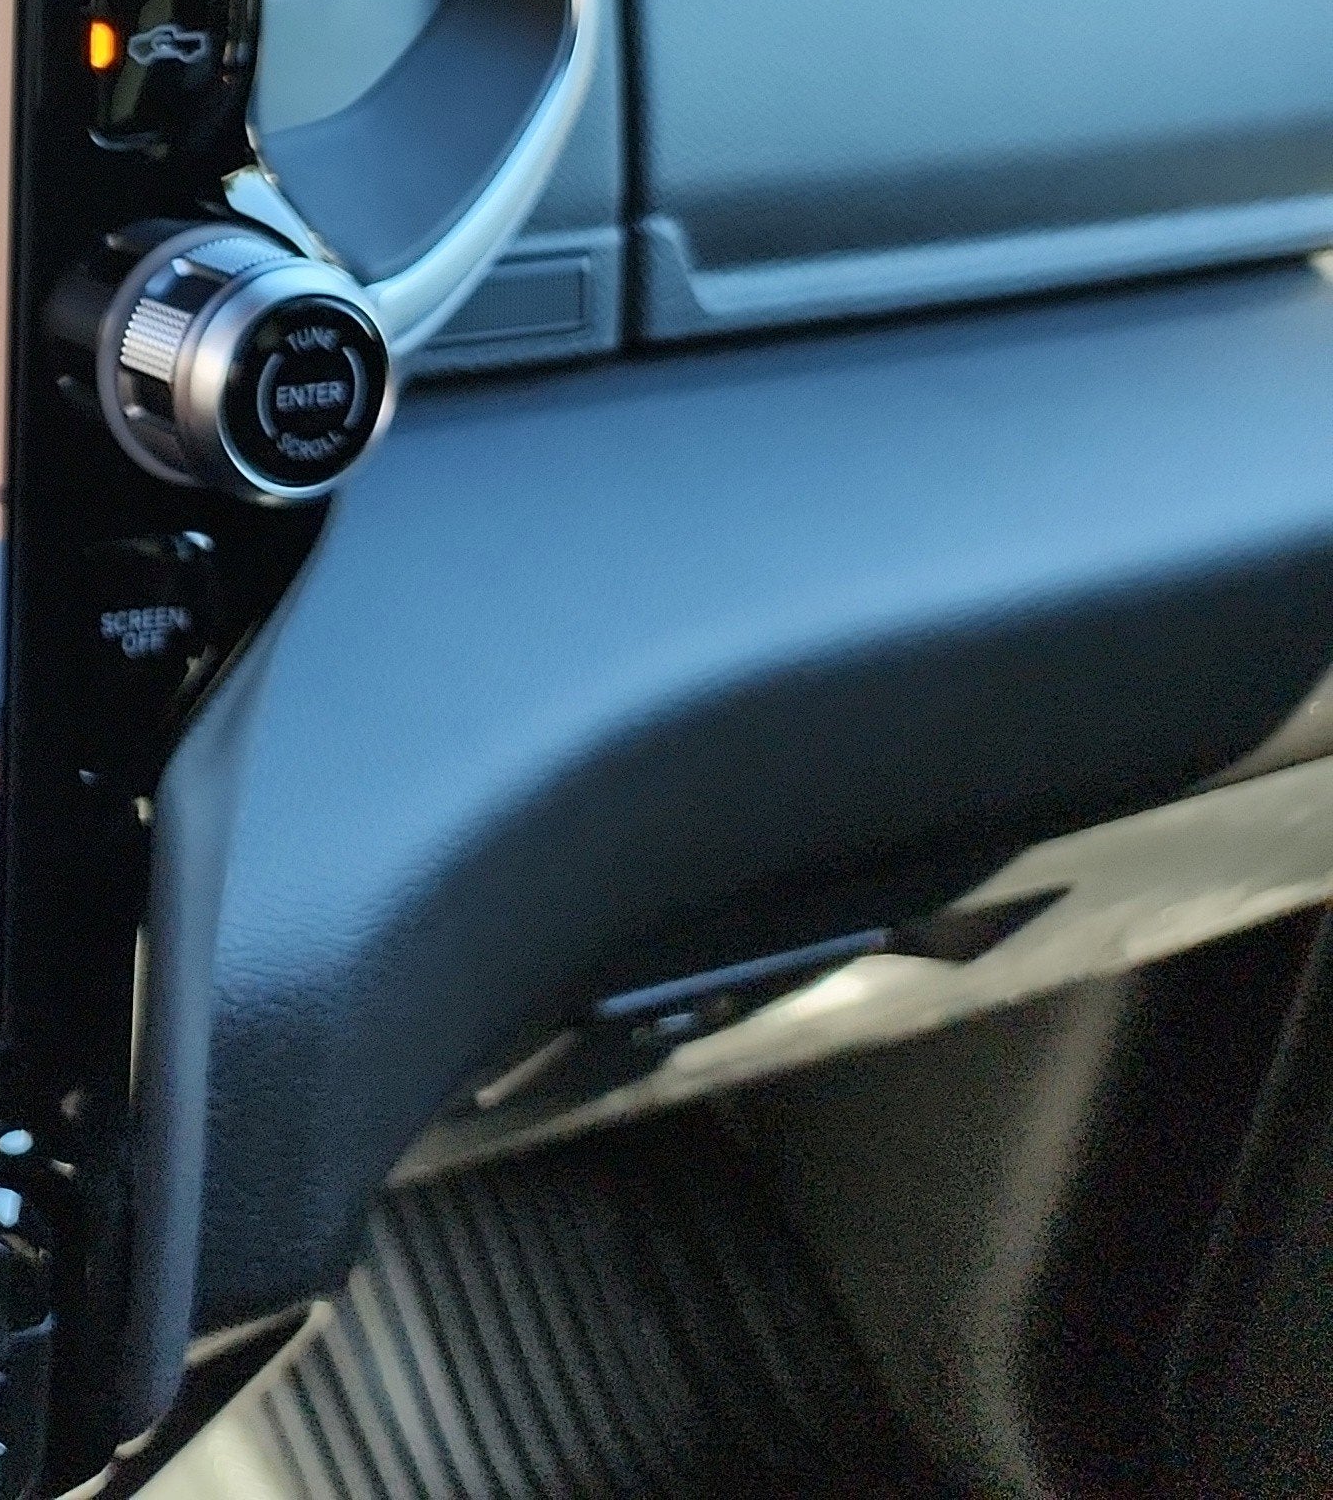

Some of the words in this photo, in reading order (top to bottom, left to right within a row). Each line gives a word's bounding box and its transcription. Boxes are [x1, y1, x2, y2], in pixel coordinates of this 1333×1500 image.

[276, 383, 346, 409] ENTER
[100, 606, 190, 637] SCREEN
[121, 633, 165, 657] OFF
